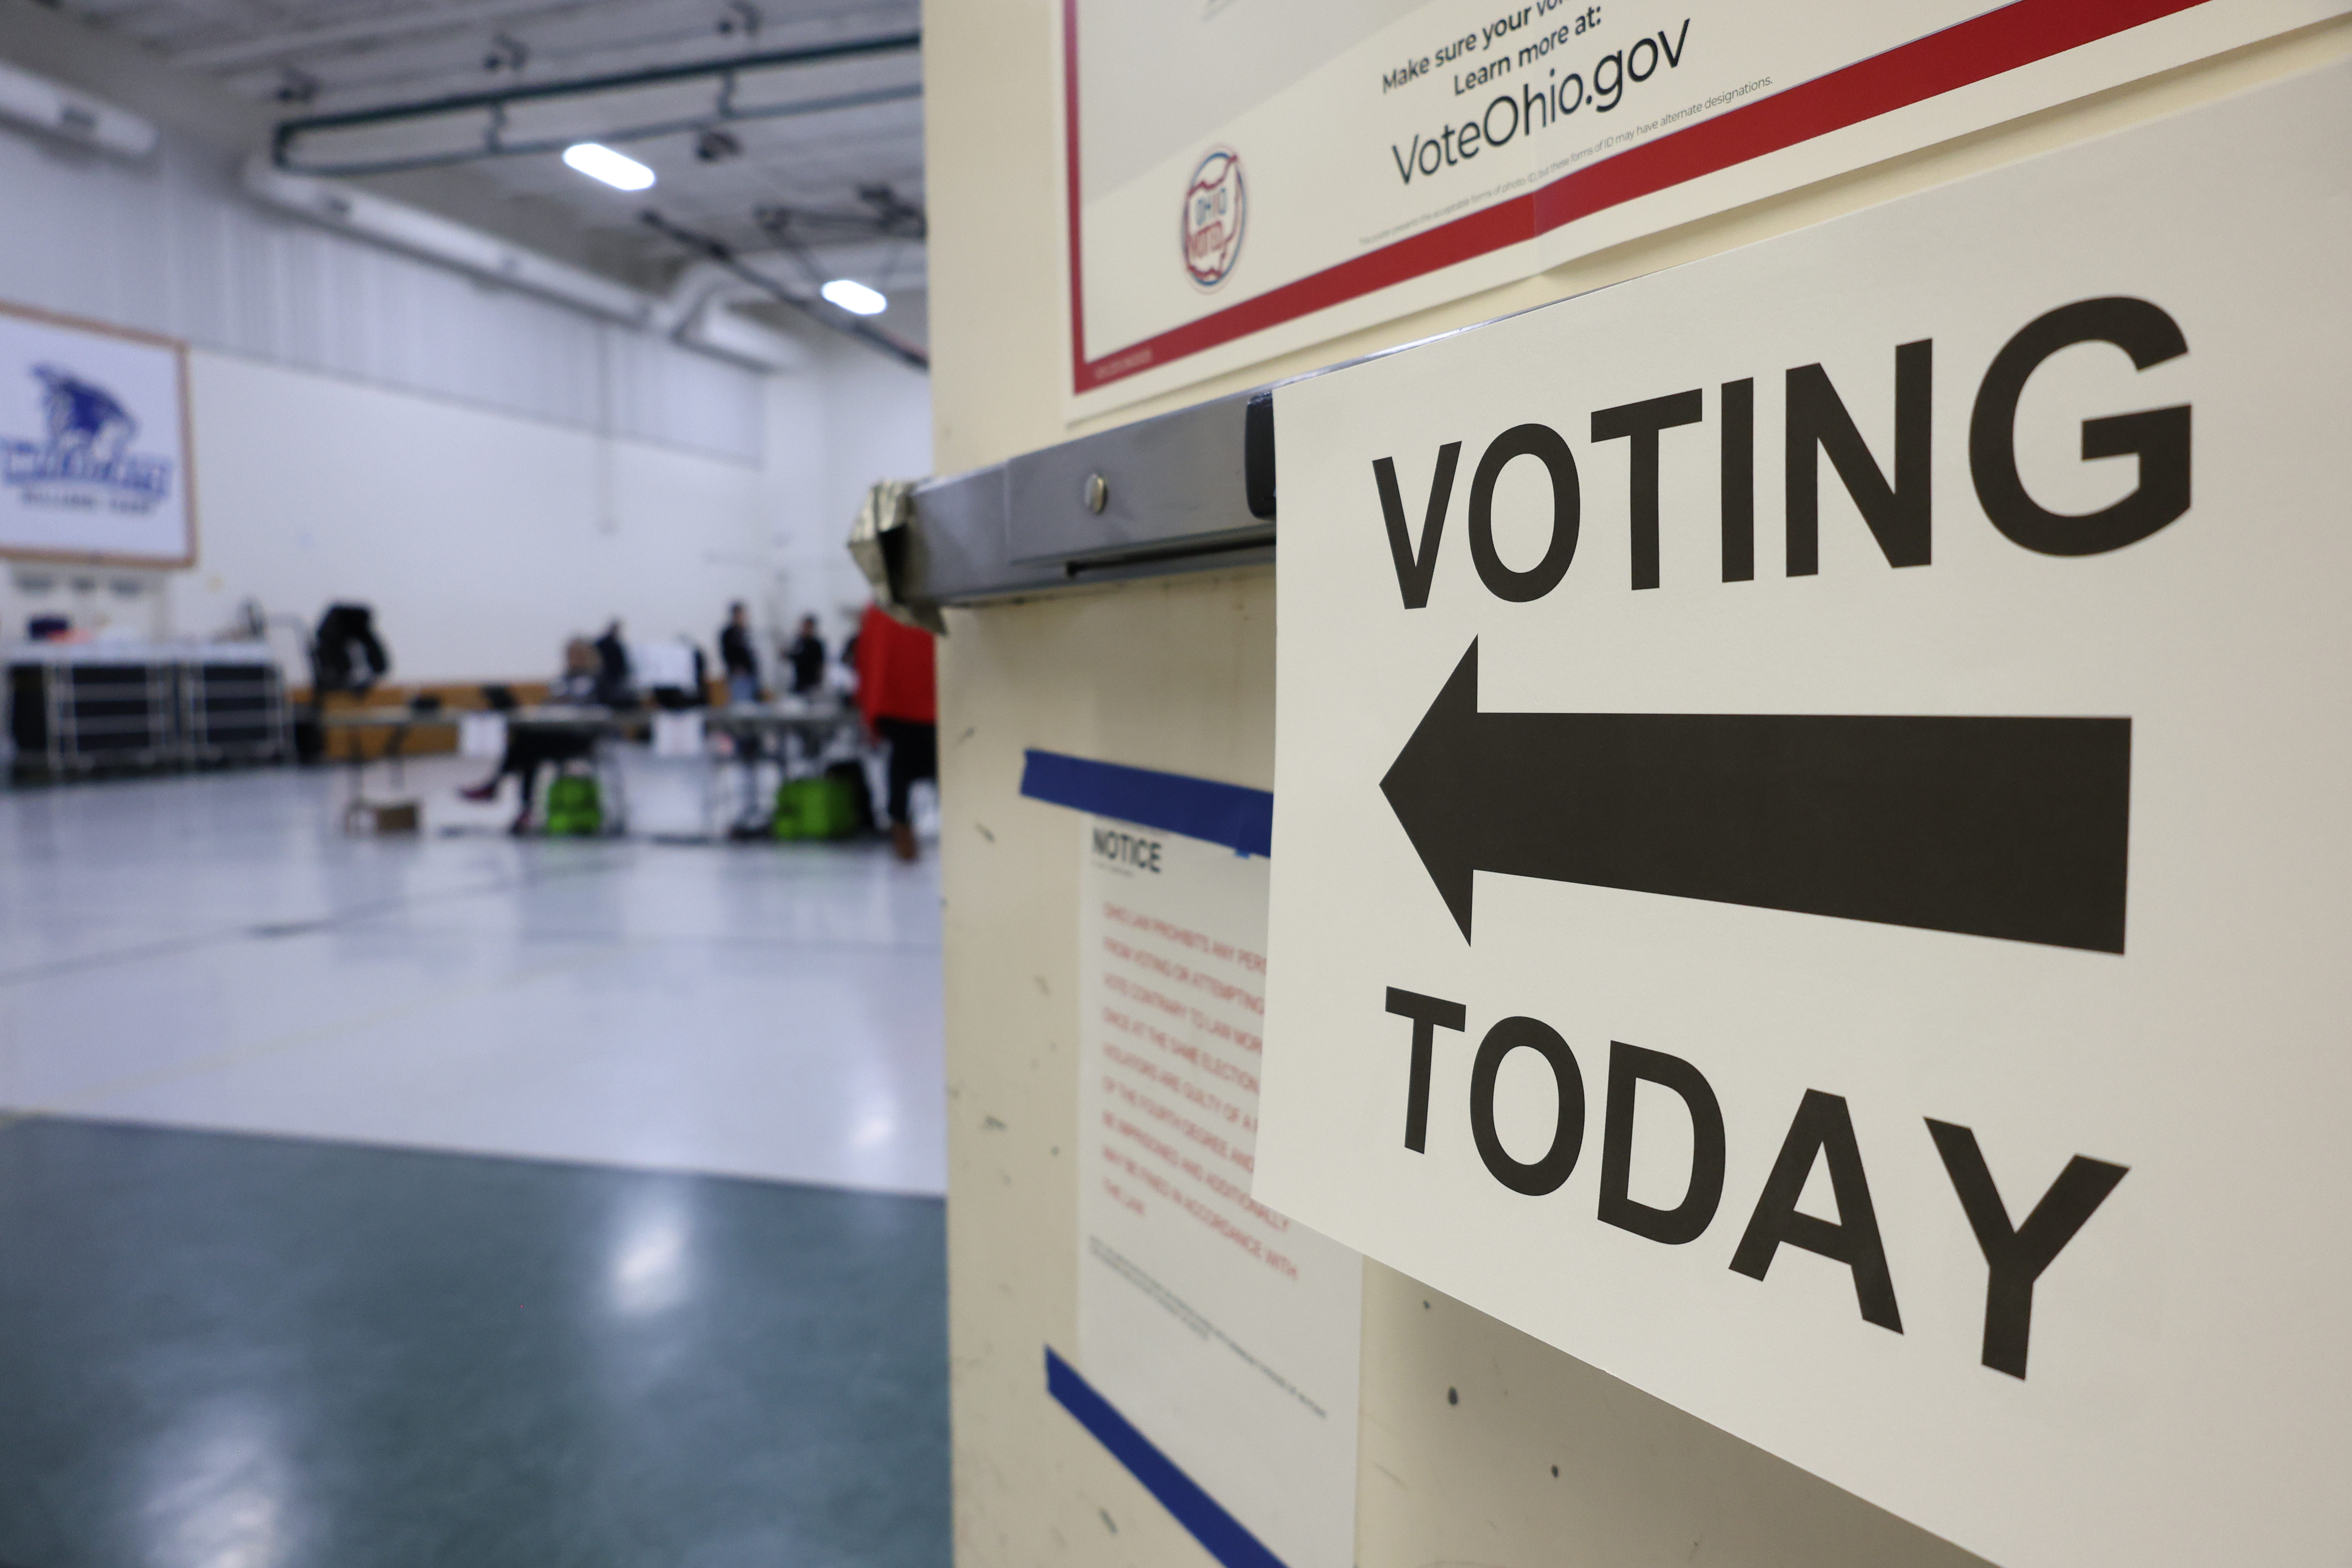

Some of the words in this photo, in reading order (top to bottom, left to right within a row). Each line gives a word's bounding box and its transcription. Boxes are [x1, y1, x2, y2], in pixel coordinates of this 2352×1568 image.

[1383, 58, 1430, 94] Make
[1435, 33, 1477, 67] sure
[1482, 6, 1532, 50] your
[1537, 0, 1563, 16] vo
[1392, 18, 1690, 185] VoteOhio.gov
[1454, 56, 1510, 96] Learn
[1518, 25, 1569, 68] more
[1575, 6, 1601, 36] at:
[1502, 177, 1526, 193] photo
[1550, 158, 1570, 173] these
[1570, 145, 1593, 162] forms
[1594, 140, 1604, 152] of
[1604, 137, 1613, 149] ID
[1615, 130, 1635, 142] may
[1636, 120, 1659, 136] have
[1660, 102, 1702, 127] alternate
[1704, 76, 1773, 109] designations.
[1372, 296, 2192, 610] VOTING
[1093, 828, 1162, 873] NOTICE
[1385, 985, 2130, 1381] TODAY
